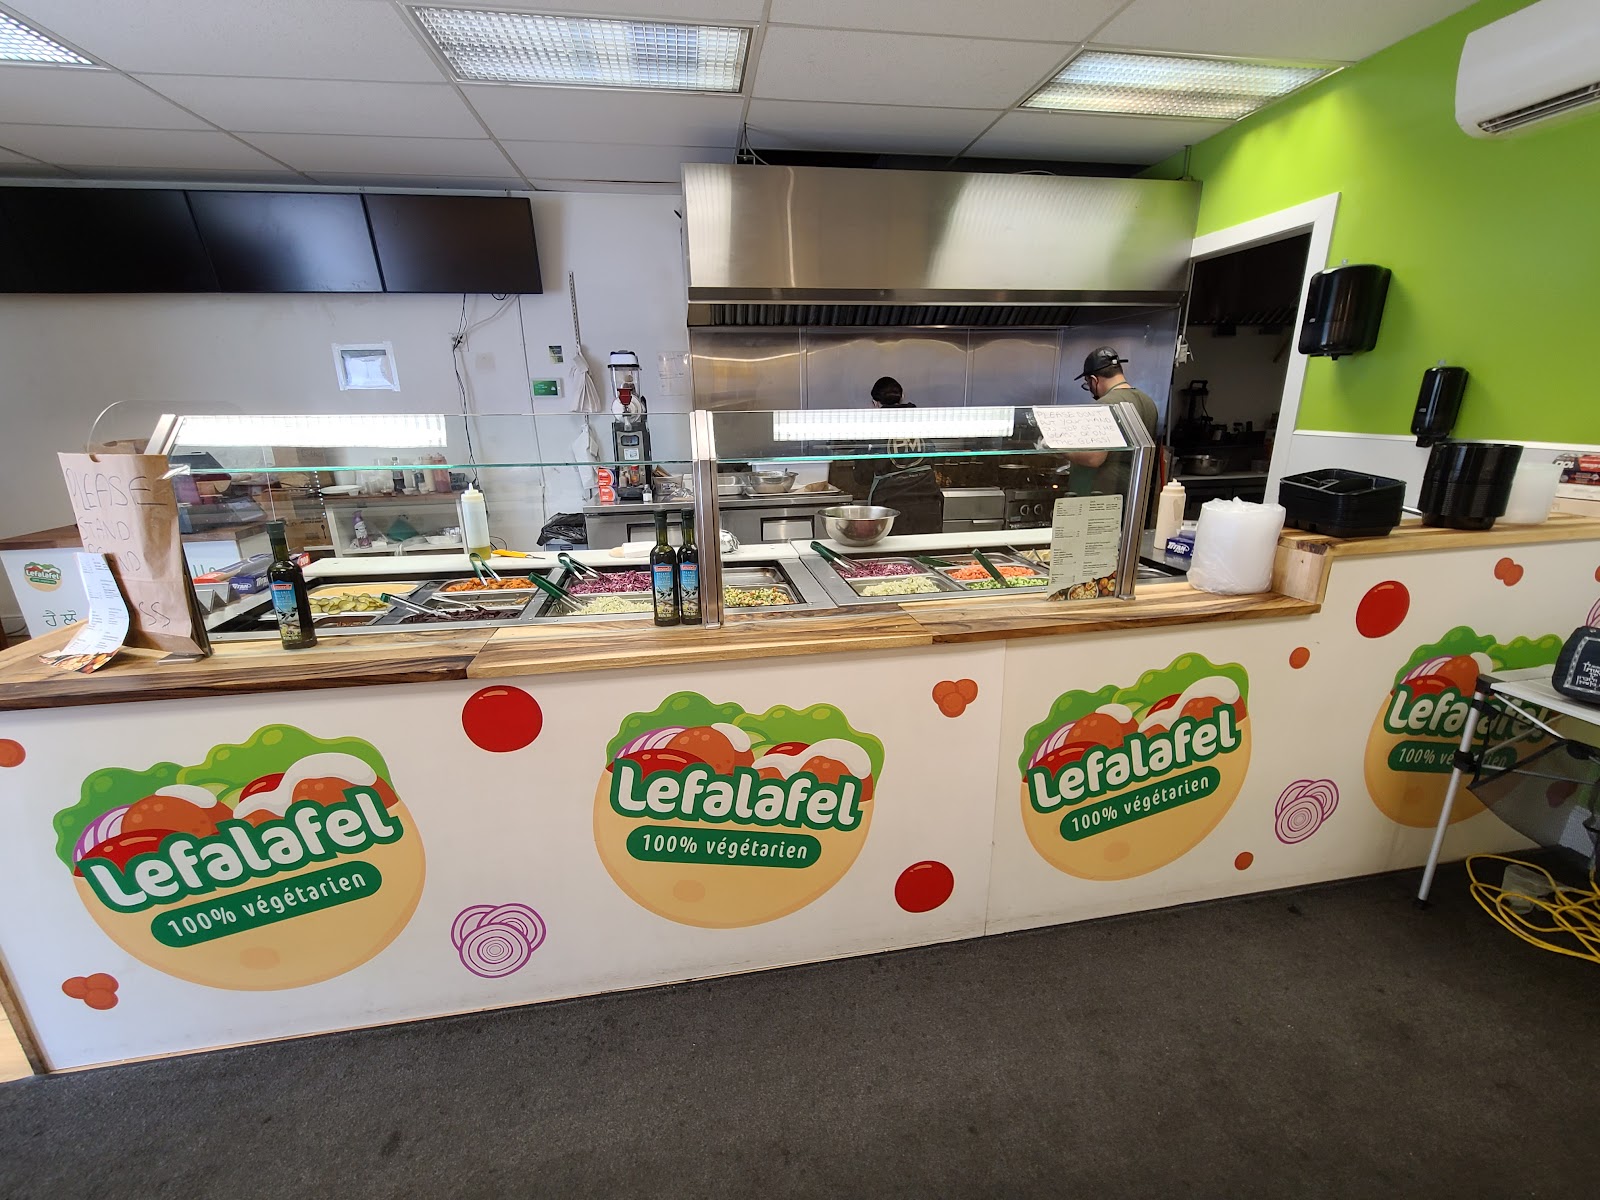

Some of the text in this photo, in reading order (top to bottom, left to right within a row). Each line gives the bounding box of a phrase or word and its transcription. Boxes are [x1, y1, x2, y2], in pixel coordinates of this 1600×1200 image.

[66, 467, 168, 511] PLEASE
[78, 516, 131, 541] STAND
[1389, 689, 1549, 740] Lefaafel
[1033, 709, 1236, 808] Lefalafel
[1398, 747, 1435, 765] 100%
[617, 765, 856, 825] Lefalafel
[1071, 776, 1209, 832] 100% végétarien
[90, 792, 395, 906] Lefalafel
[642, 834, 808, 860] 100% végétarien
[167, 872, 367, 938] 100% végétarien
